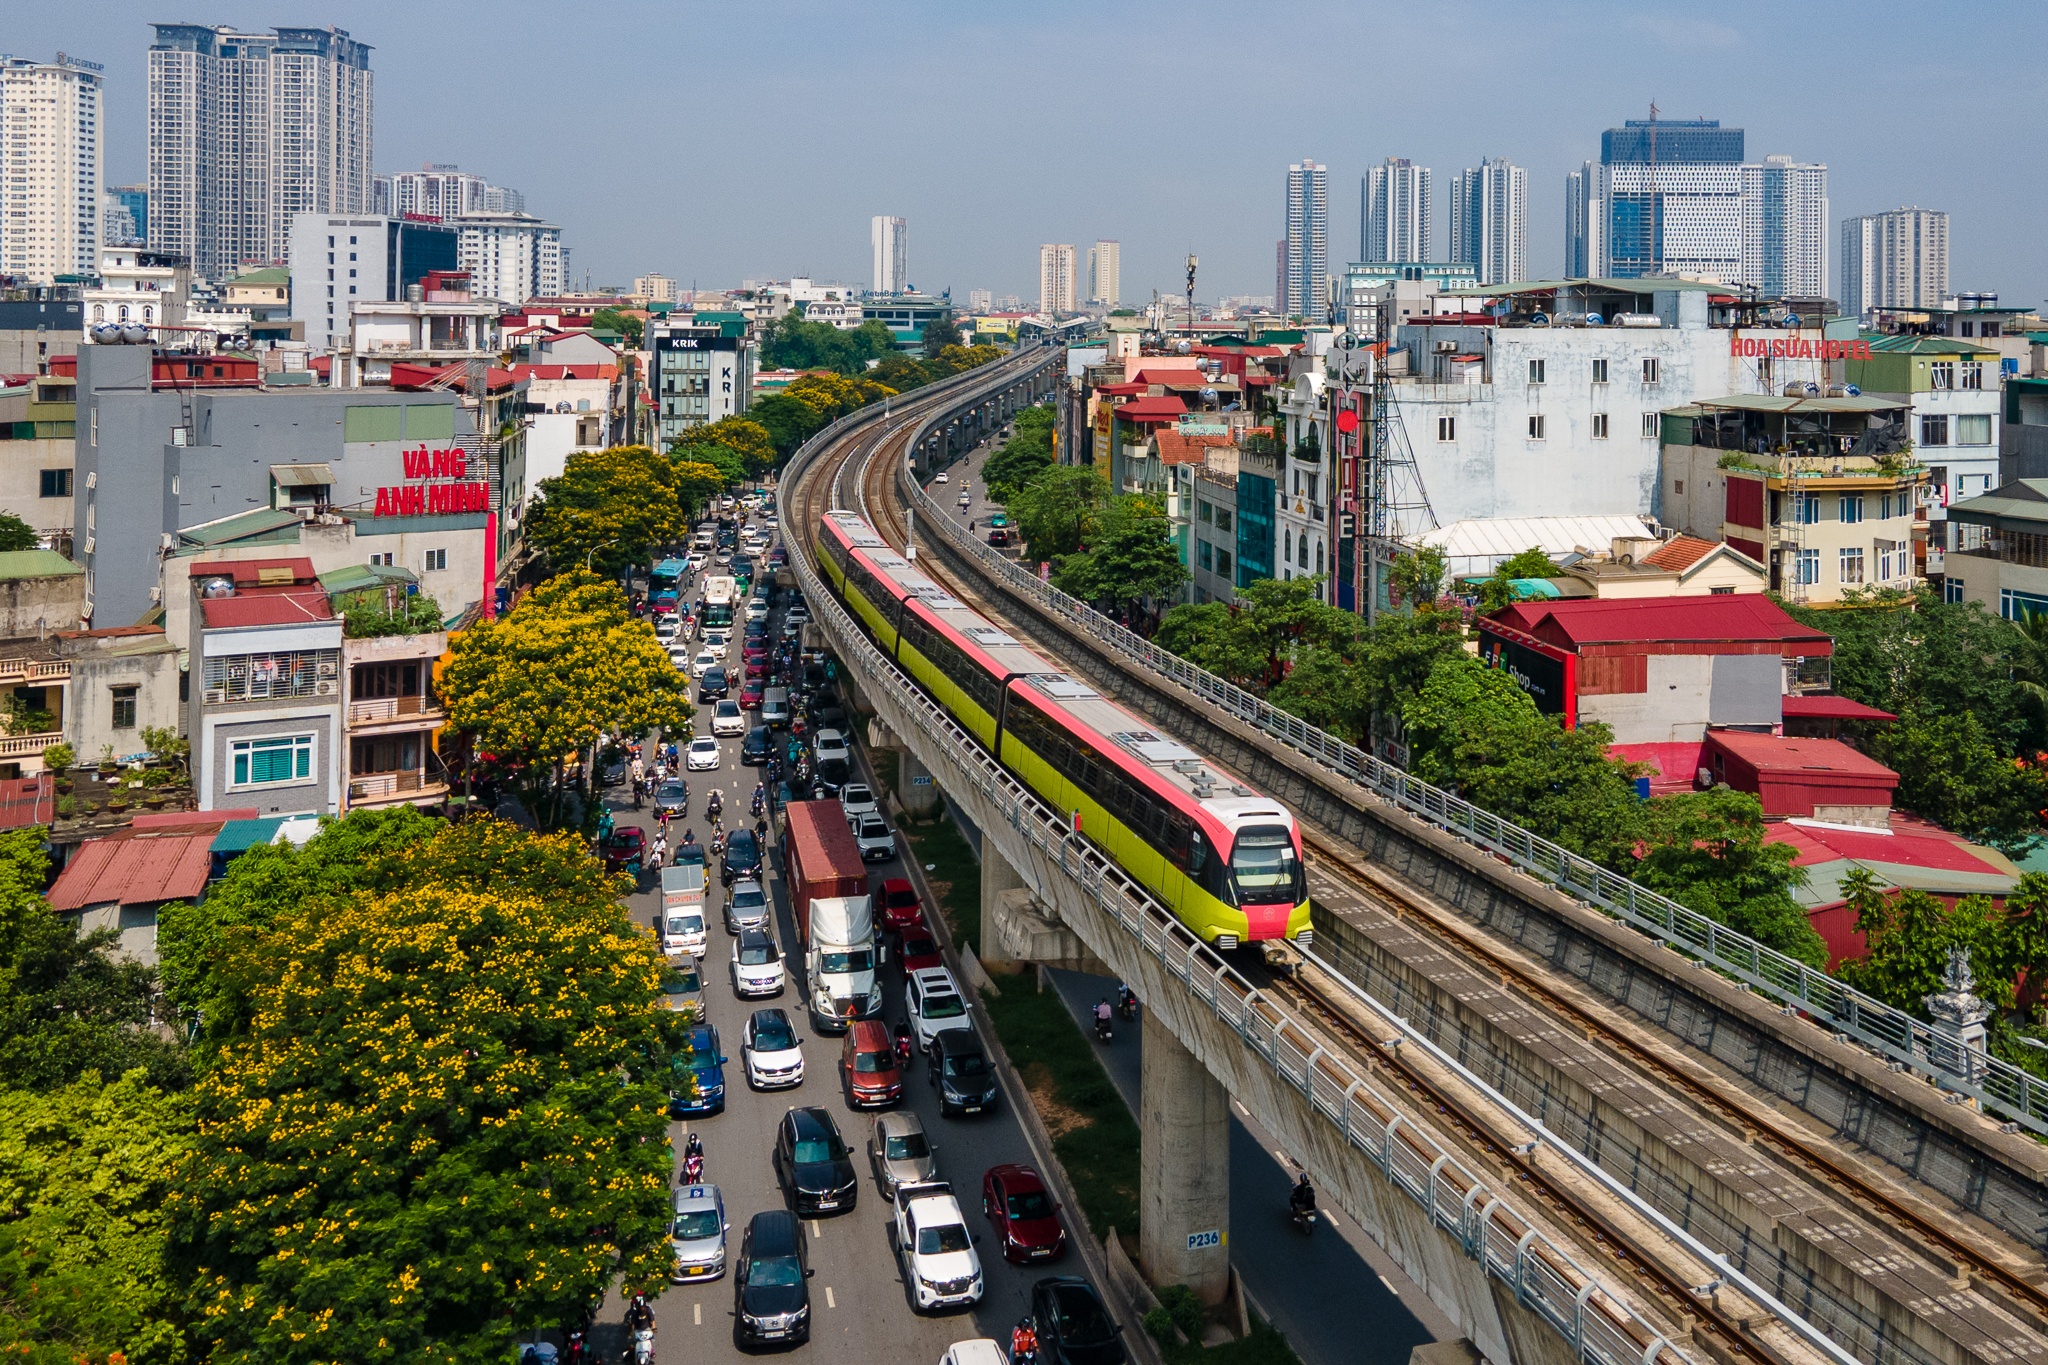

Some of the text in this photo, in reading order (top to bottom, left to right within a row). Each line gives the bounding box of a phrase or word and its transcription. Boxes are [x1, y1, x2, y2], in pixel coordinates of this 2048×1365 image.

[672, 339, 698, 348] KRIK
[1731, 334, 1874, 360] HOA SỮA HOTEL
[402, 444, 466, 478] VÀNG
[374, 482, 489, 517] ANH MINH
[1485, 650, 1505, 669] FPT
[1509, 665, 1530, 690] Shop
[1189, 1231, 1219, 1248] P236
